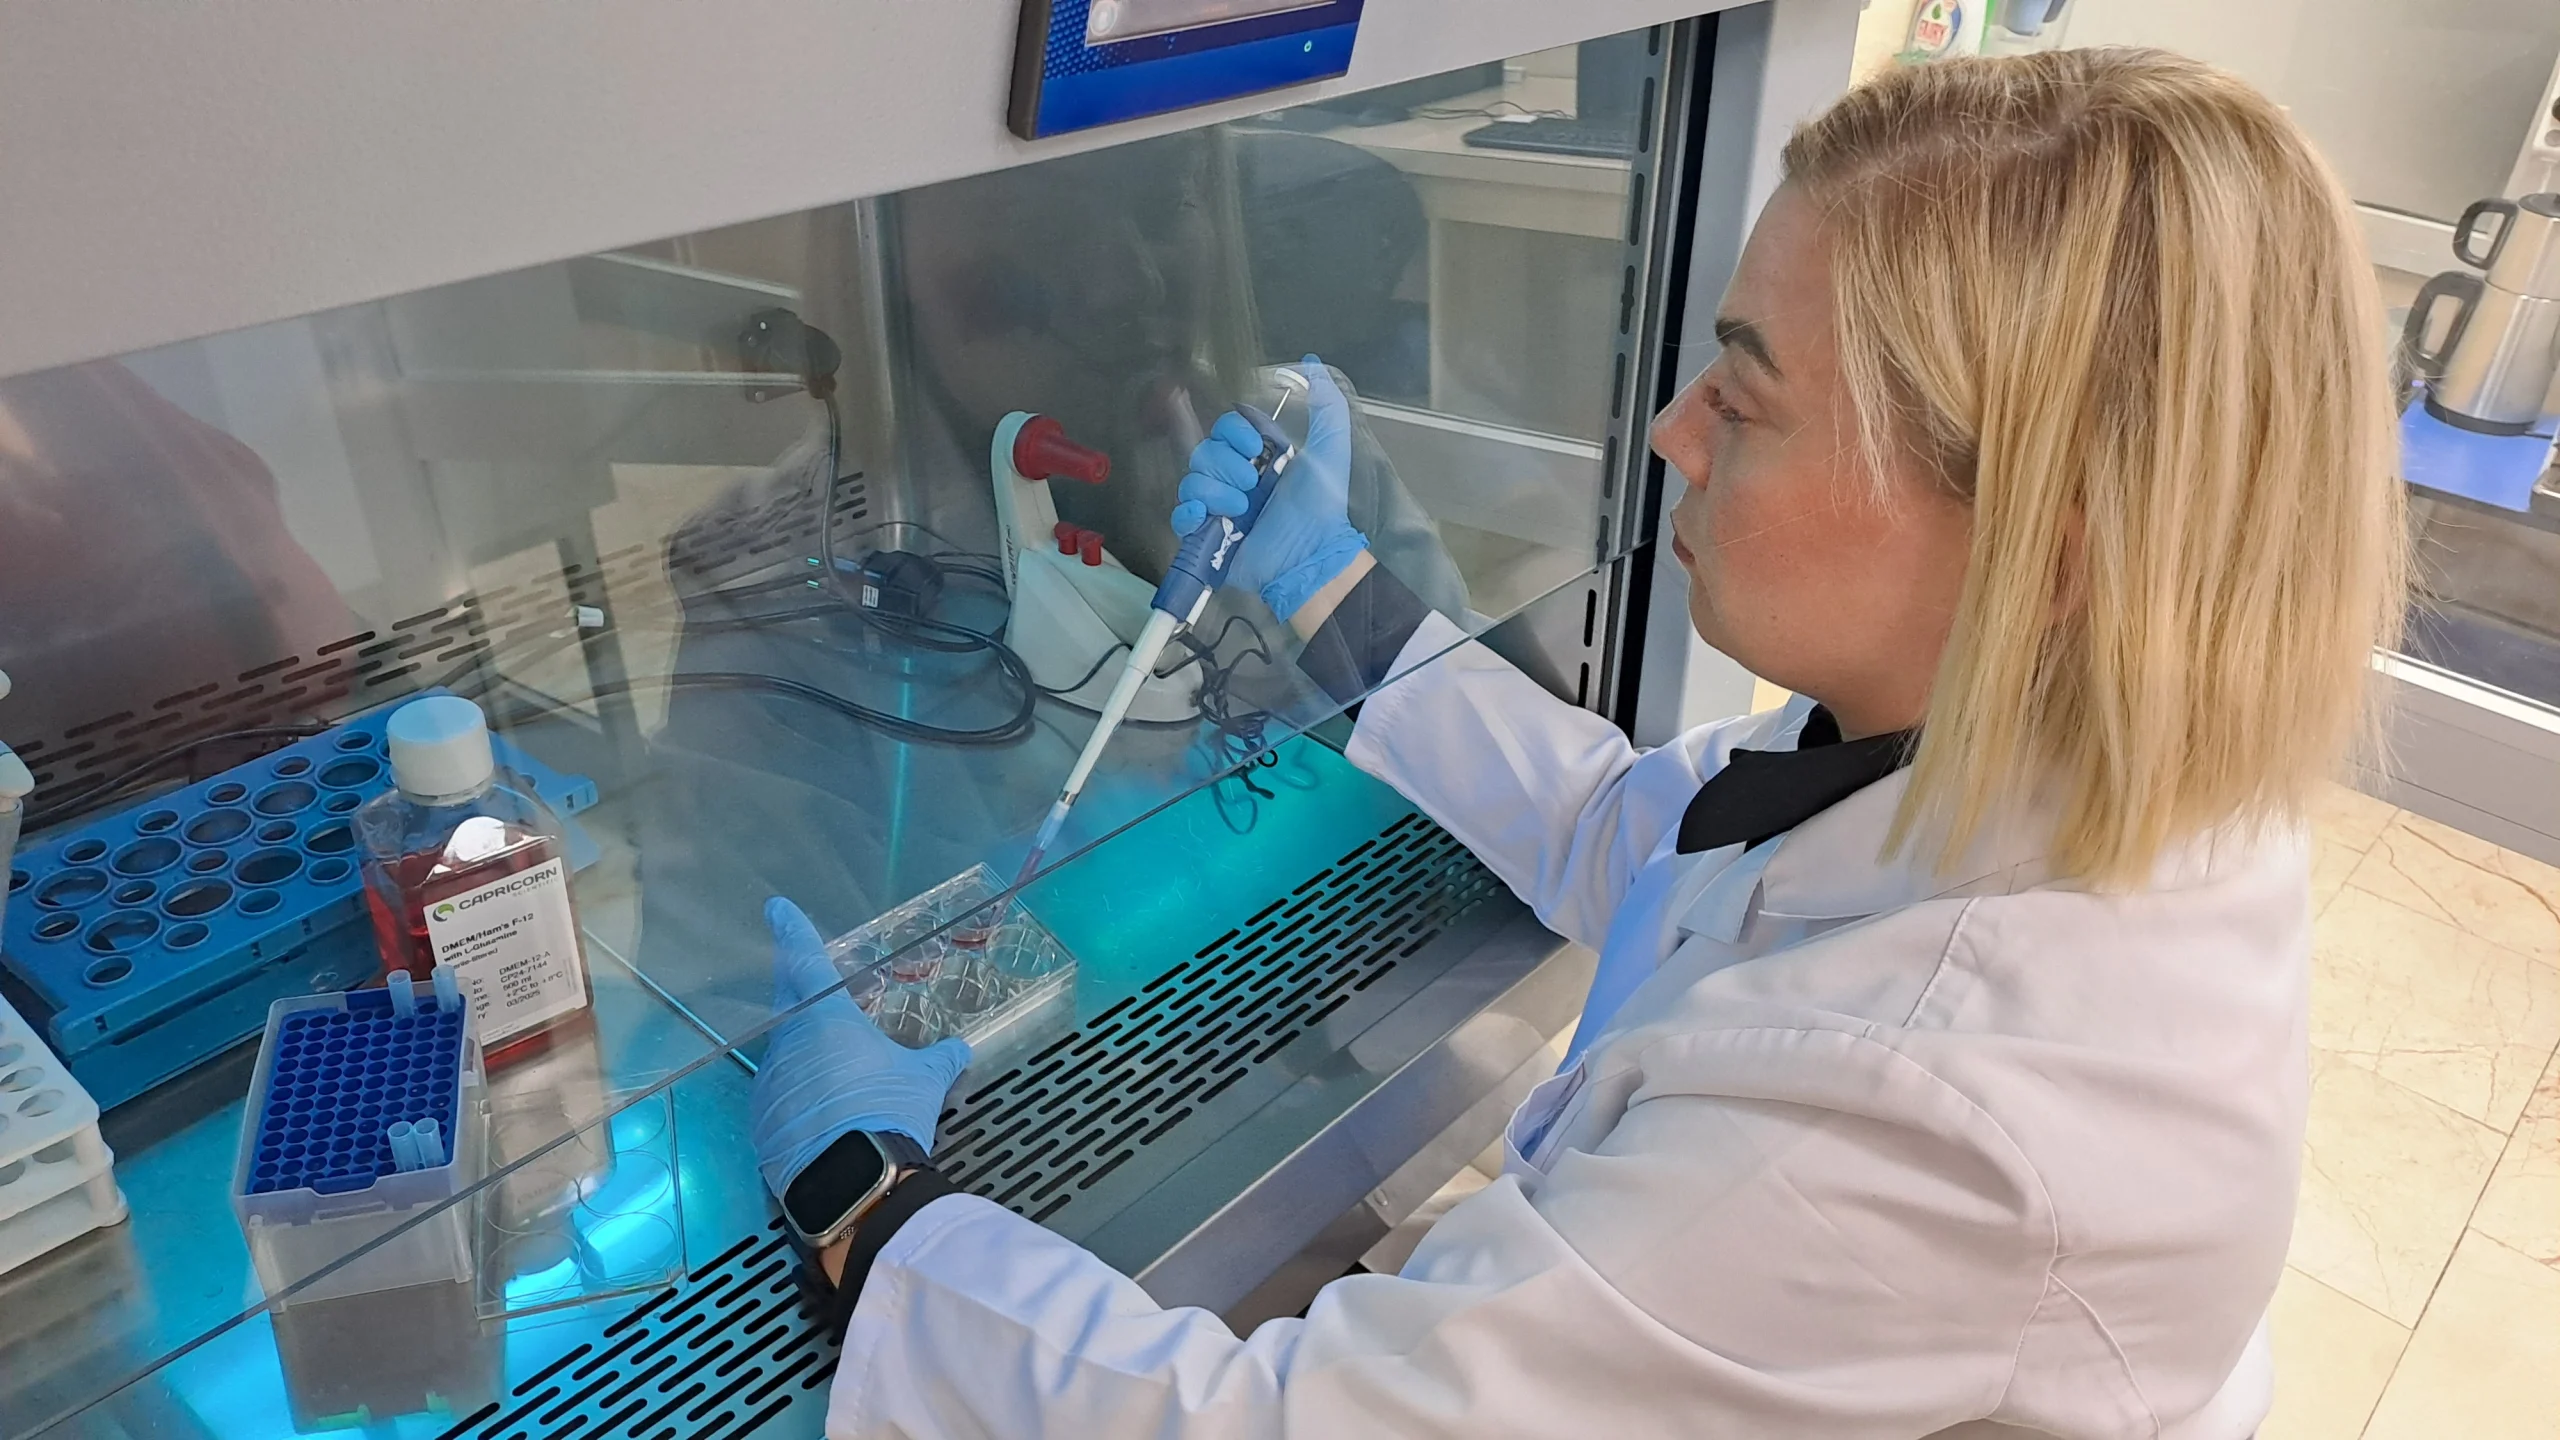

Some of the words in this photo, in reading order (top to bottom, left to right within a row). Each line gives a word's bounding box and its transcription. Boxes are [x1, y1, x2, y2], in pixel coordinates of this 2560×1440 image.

[458, 866, 557, 911] CAPRICORN
[441, 922, 510, 954] DMEM/Ham's
[512, 913, 534, 927] F-12
[443, 950, 463, 963] with
[464, 929, 518, 955] L-Glutamine
[500, 960, 548, 984] CP24-7144
[521, 975, 533, 985] ml
[530, 981, 540, 990] to
[506, 989, 542, 1008] 03/2025
